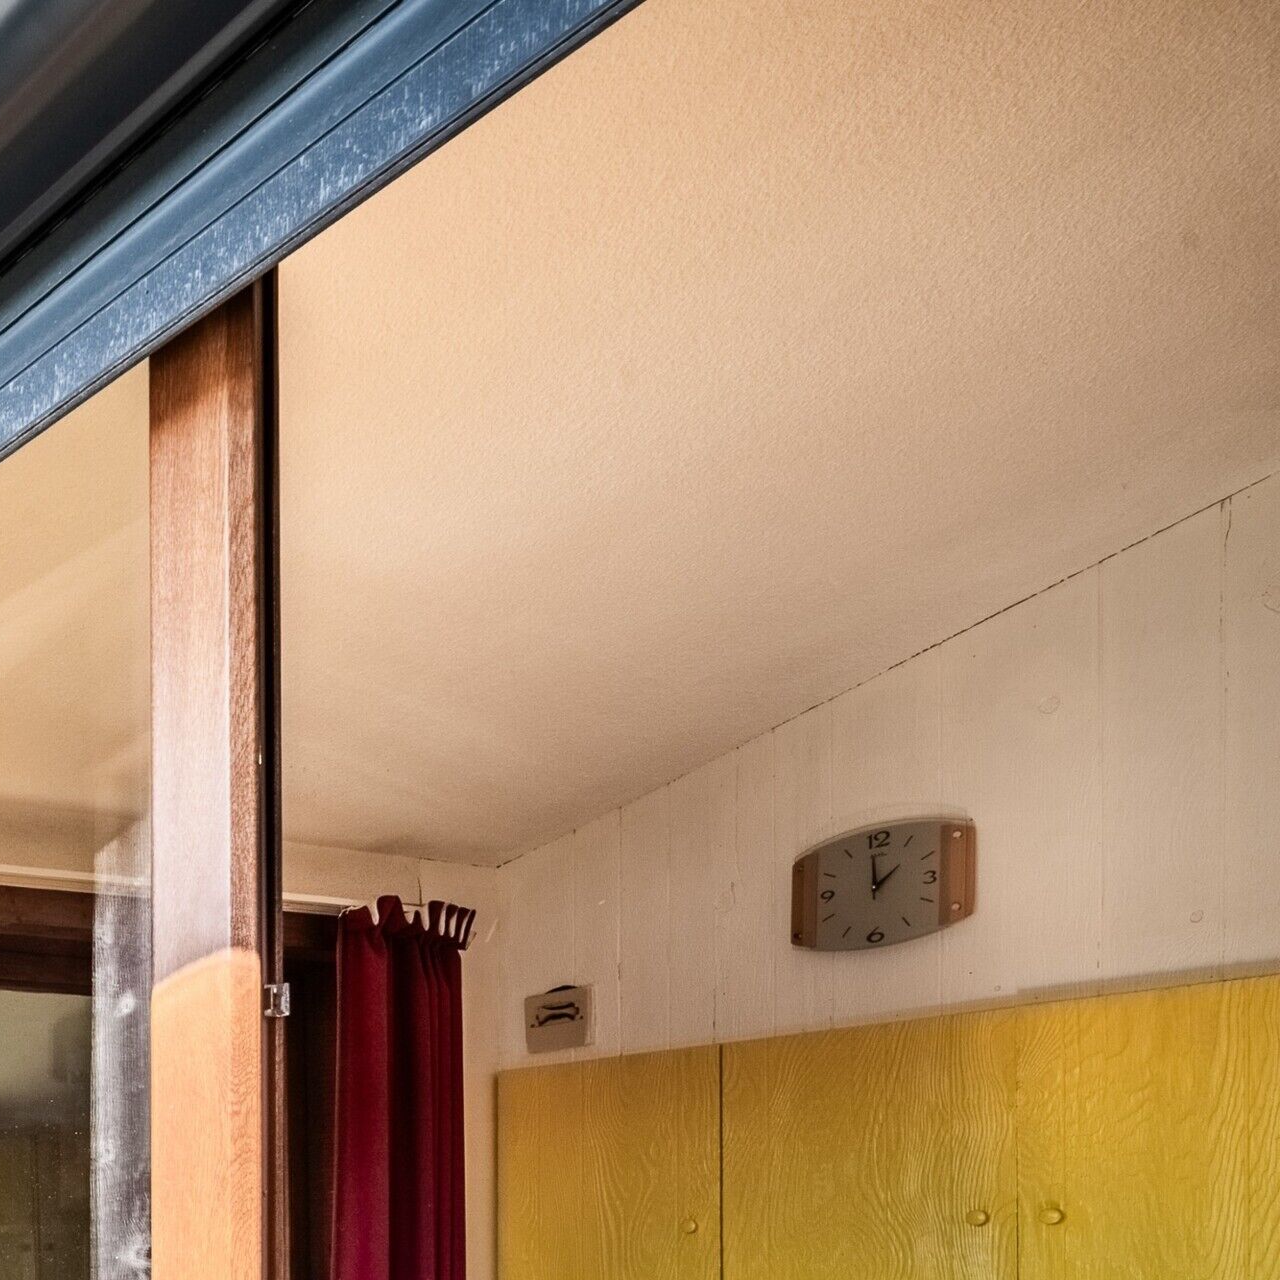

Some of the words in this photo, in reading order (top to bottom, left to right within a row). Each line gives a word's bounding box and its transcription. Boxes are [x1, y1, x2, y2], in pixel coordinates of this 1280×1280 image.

[867, 830, 890, 849] 12
[923, 870, 937, 884] 3
[820, 890, 835, 904] 9
[866, 926, 884, 943] 6
